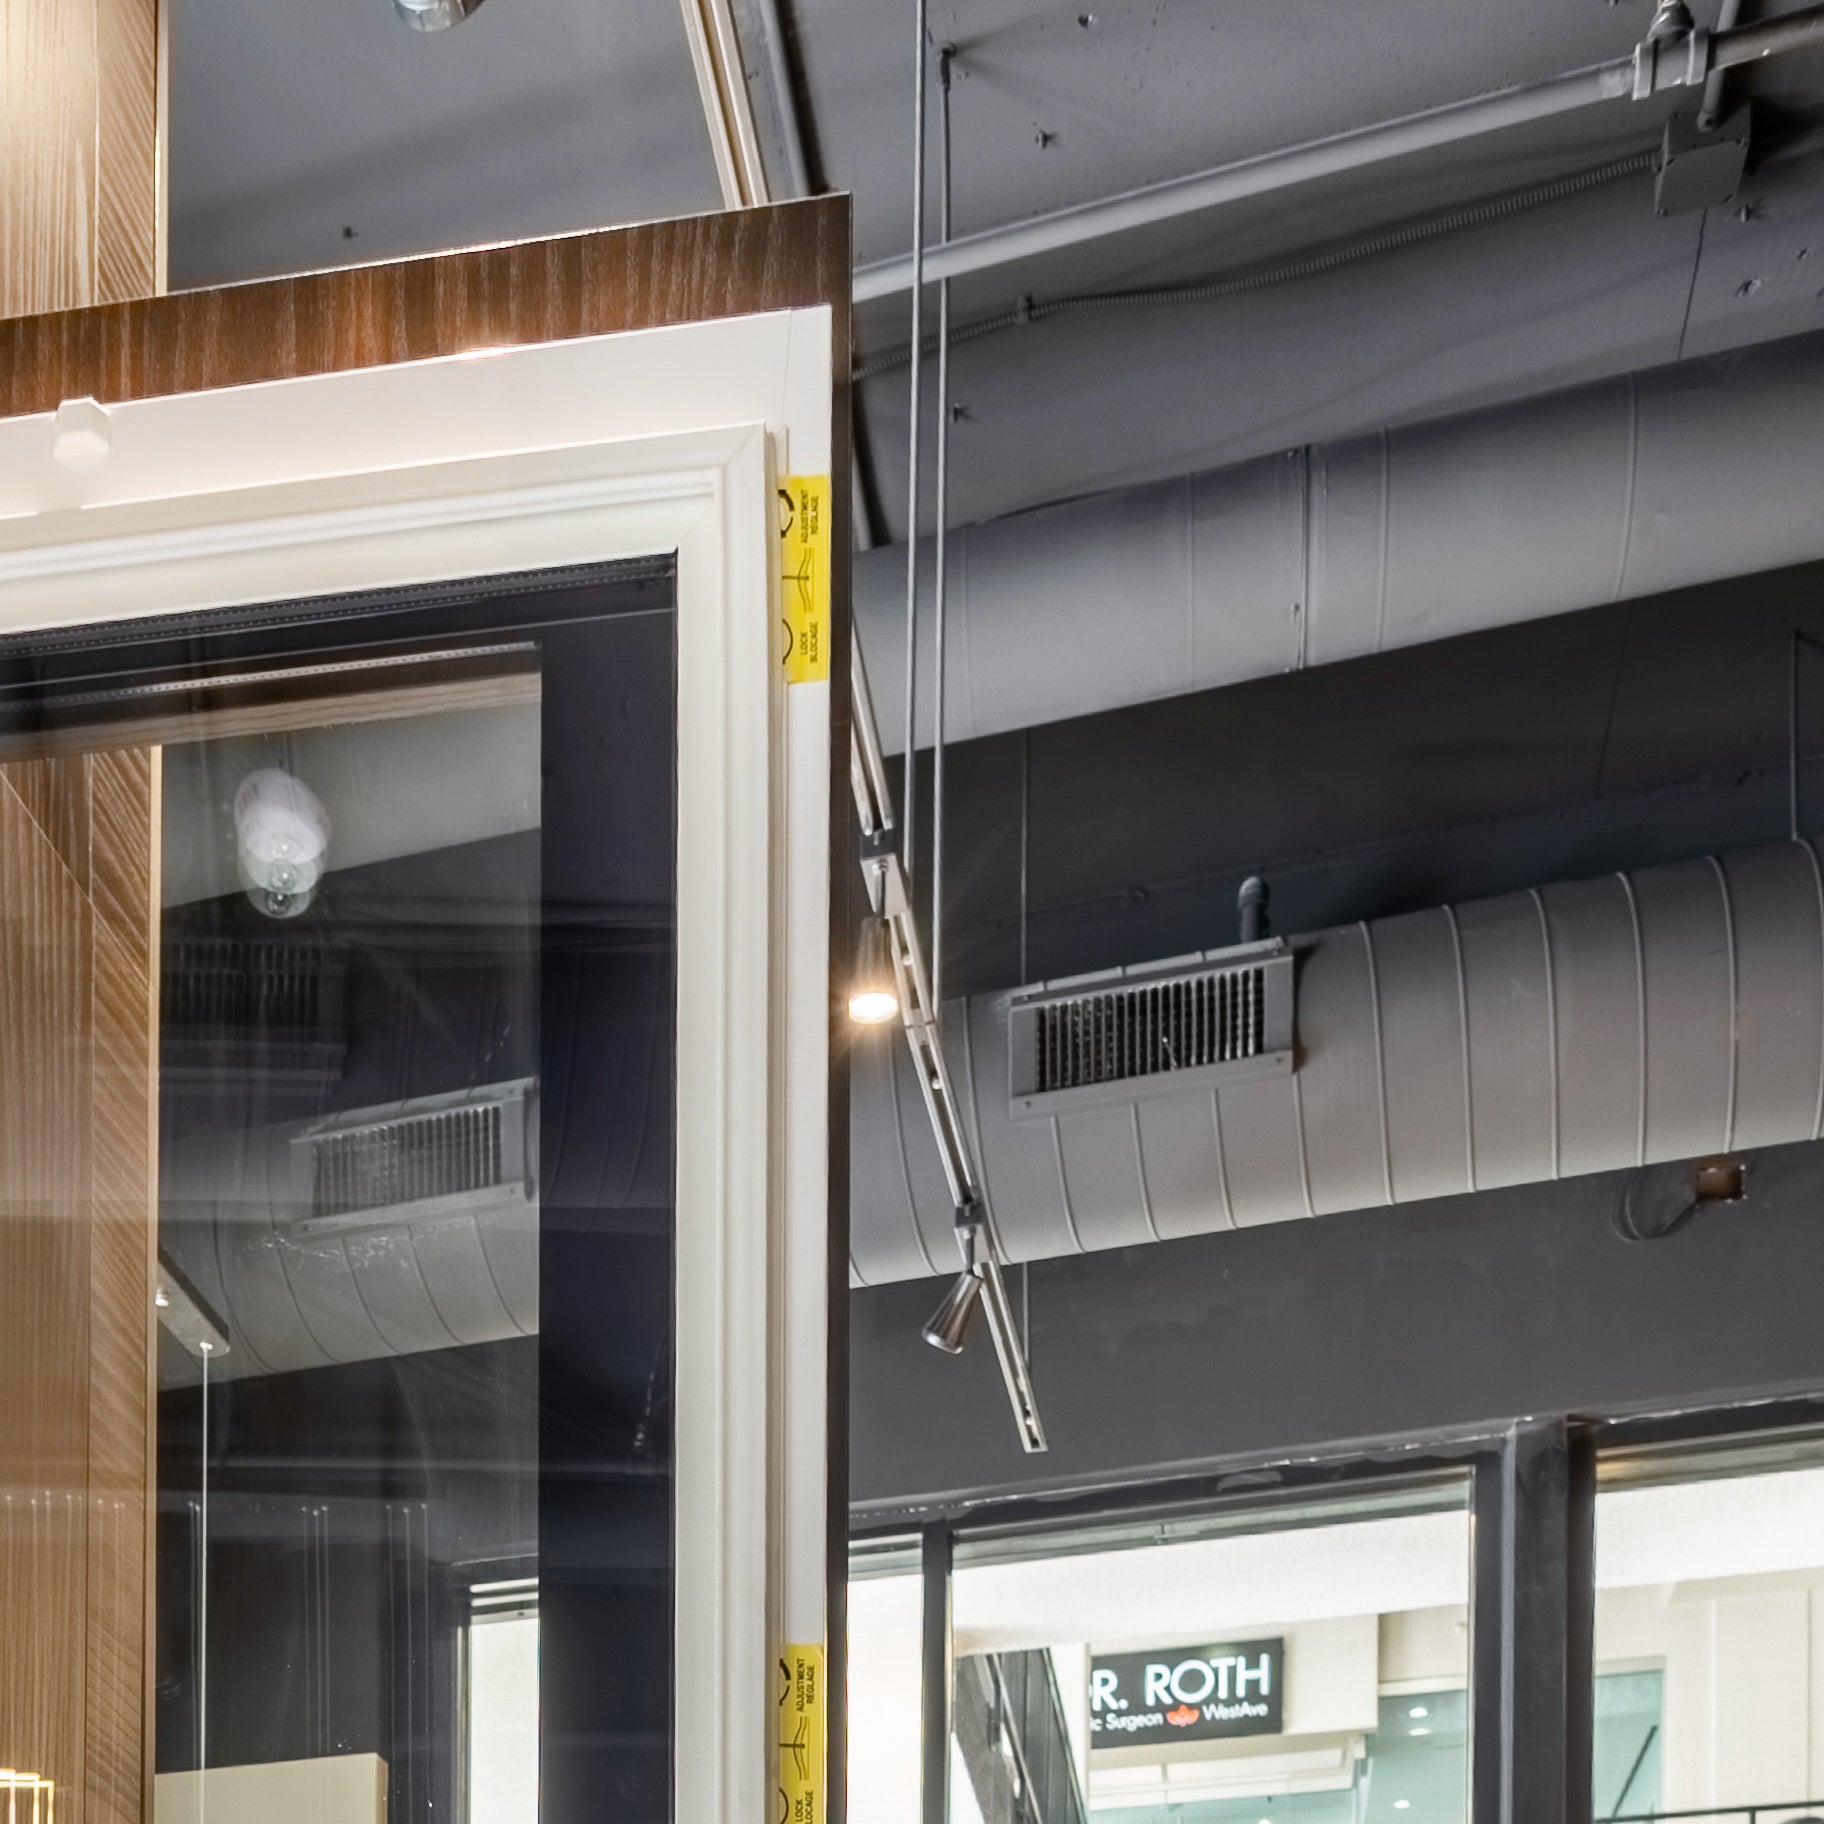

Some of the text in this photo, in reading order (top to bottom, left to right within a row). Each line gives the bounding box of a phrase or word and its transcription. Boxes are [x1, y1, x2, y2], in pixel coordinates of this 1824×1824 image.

[799, 631, 809, 655] LOCK
[796, 1657, 805, 1713] ADJUSTMENT
[1088, 1653, 1271, 1711] R. ROTH
[1105, 1712, 1165, 1732] Surgeon
[1201, 1701, 1269, 1722] WestAve
[795, 1798, 804, 1823] LOCK
